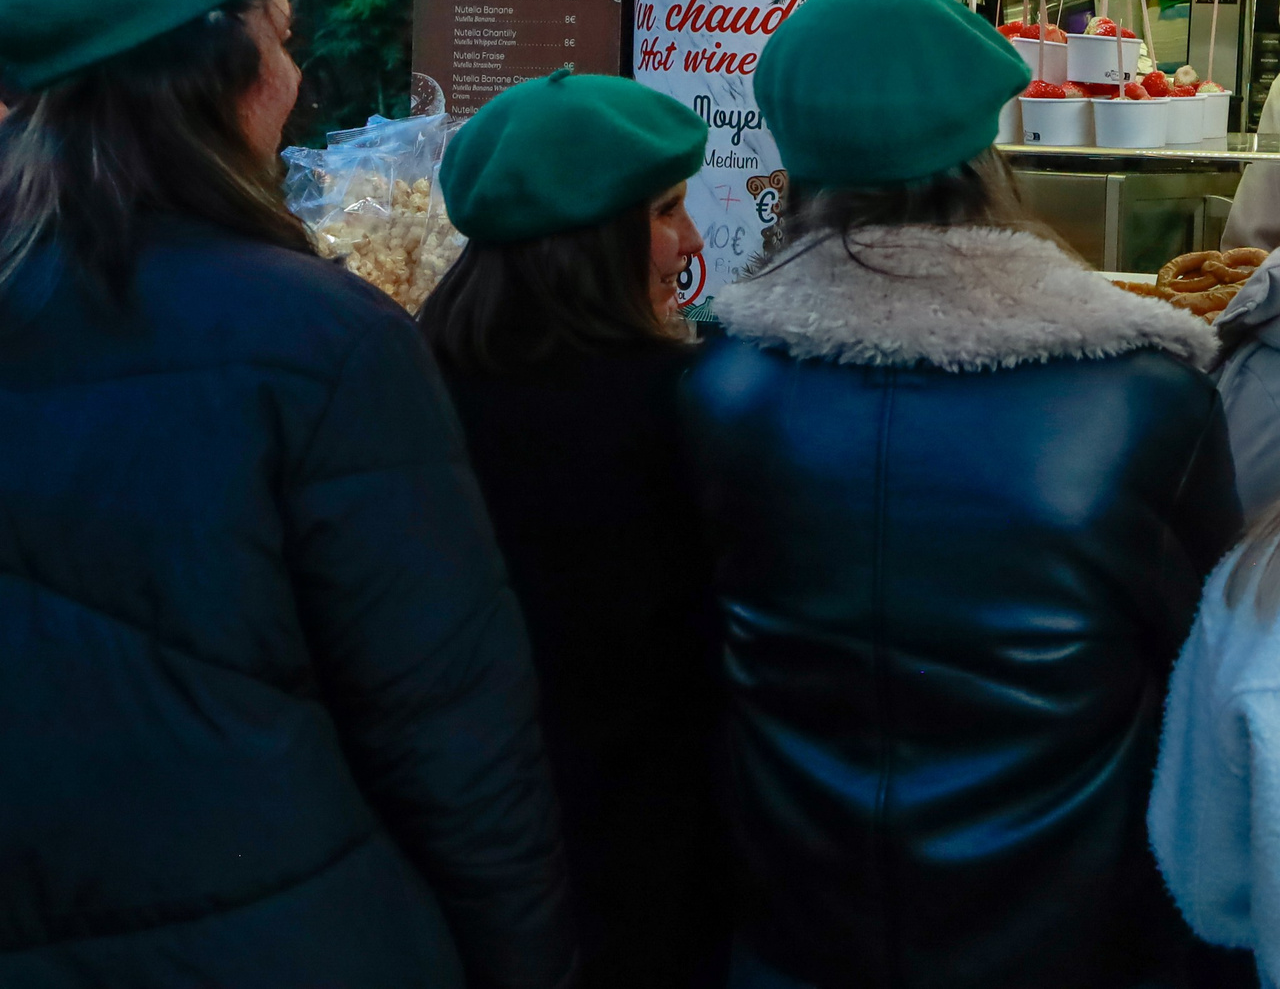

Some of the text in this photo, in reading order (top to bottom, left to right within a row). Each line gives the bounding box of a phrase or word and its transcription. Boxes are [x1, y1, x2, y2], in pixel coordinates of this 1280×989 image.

[484, 6, 513, 14] Banane
[483, 29, 516, 38] Chantilly
[565, 39, 575, 47] 8€
[482, 52, 505, 60] Fraise
[637, 36, 758, 76] Hot wine
[453, 74, 511, 83] Nutella Banane
